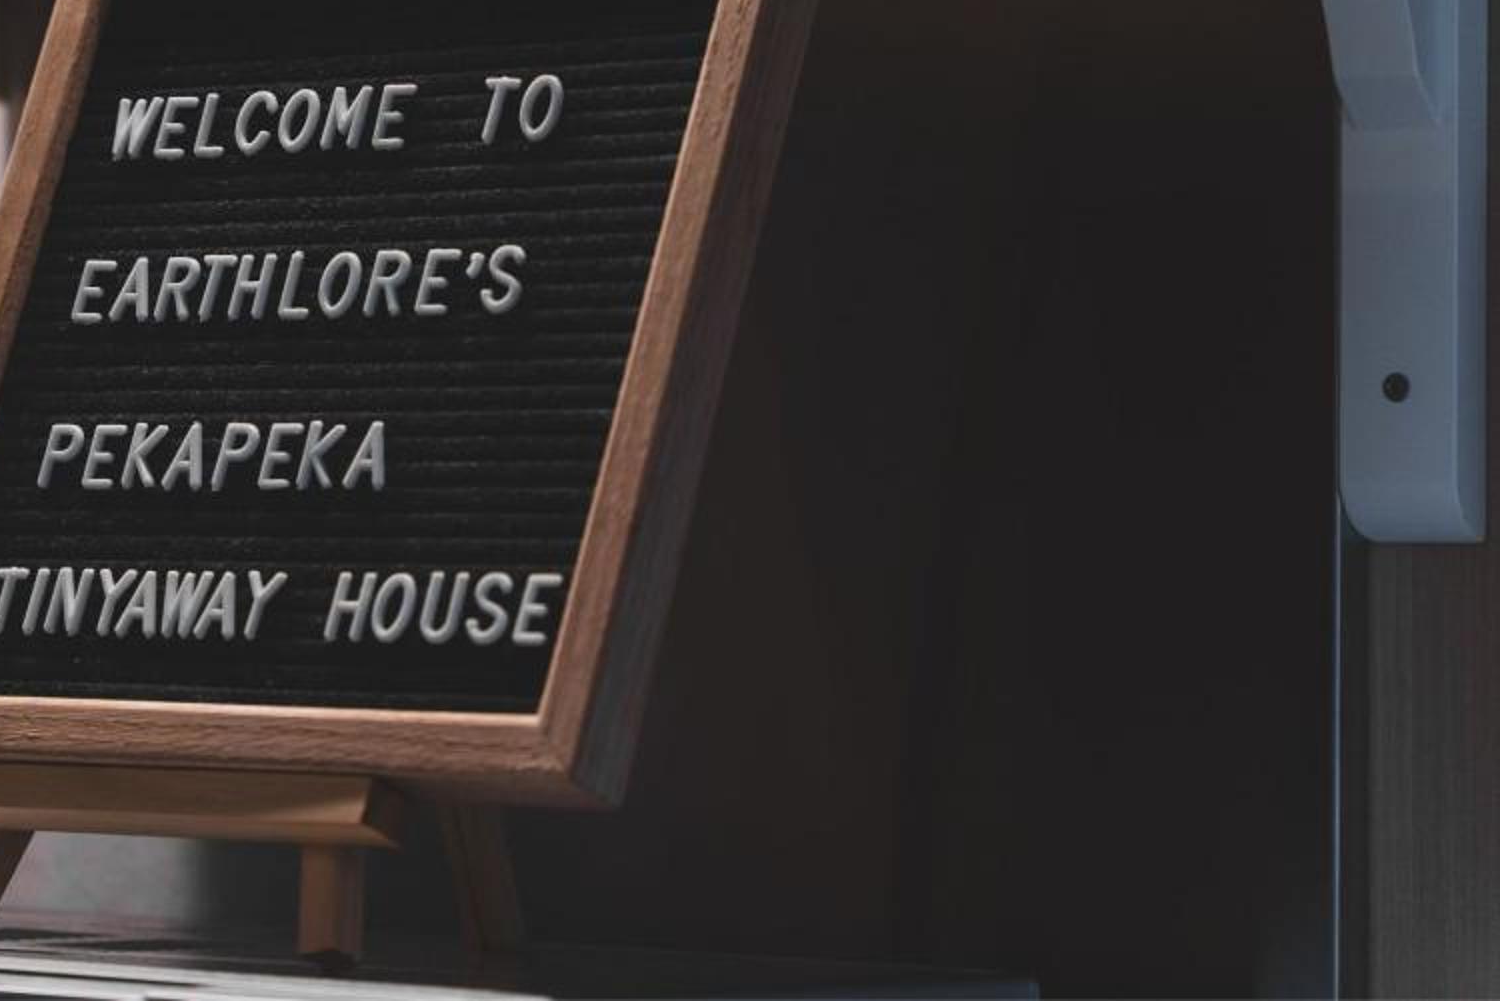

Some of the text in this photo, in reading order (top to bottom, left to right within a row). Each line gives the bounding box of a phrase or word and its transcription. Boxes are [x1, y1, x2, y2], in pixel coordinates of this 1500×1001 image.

[112, 74, 563, 159] WELCOME TO
[71, 244, 526, 322] EARTHLORE'S
[37, 420, 384, 491] PEKAPEKA
[324, 570, 564, 645] HOUSE
